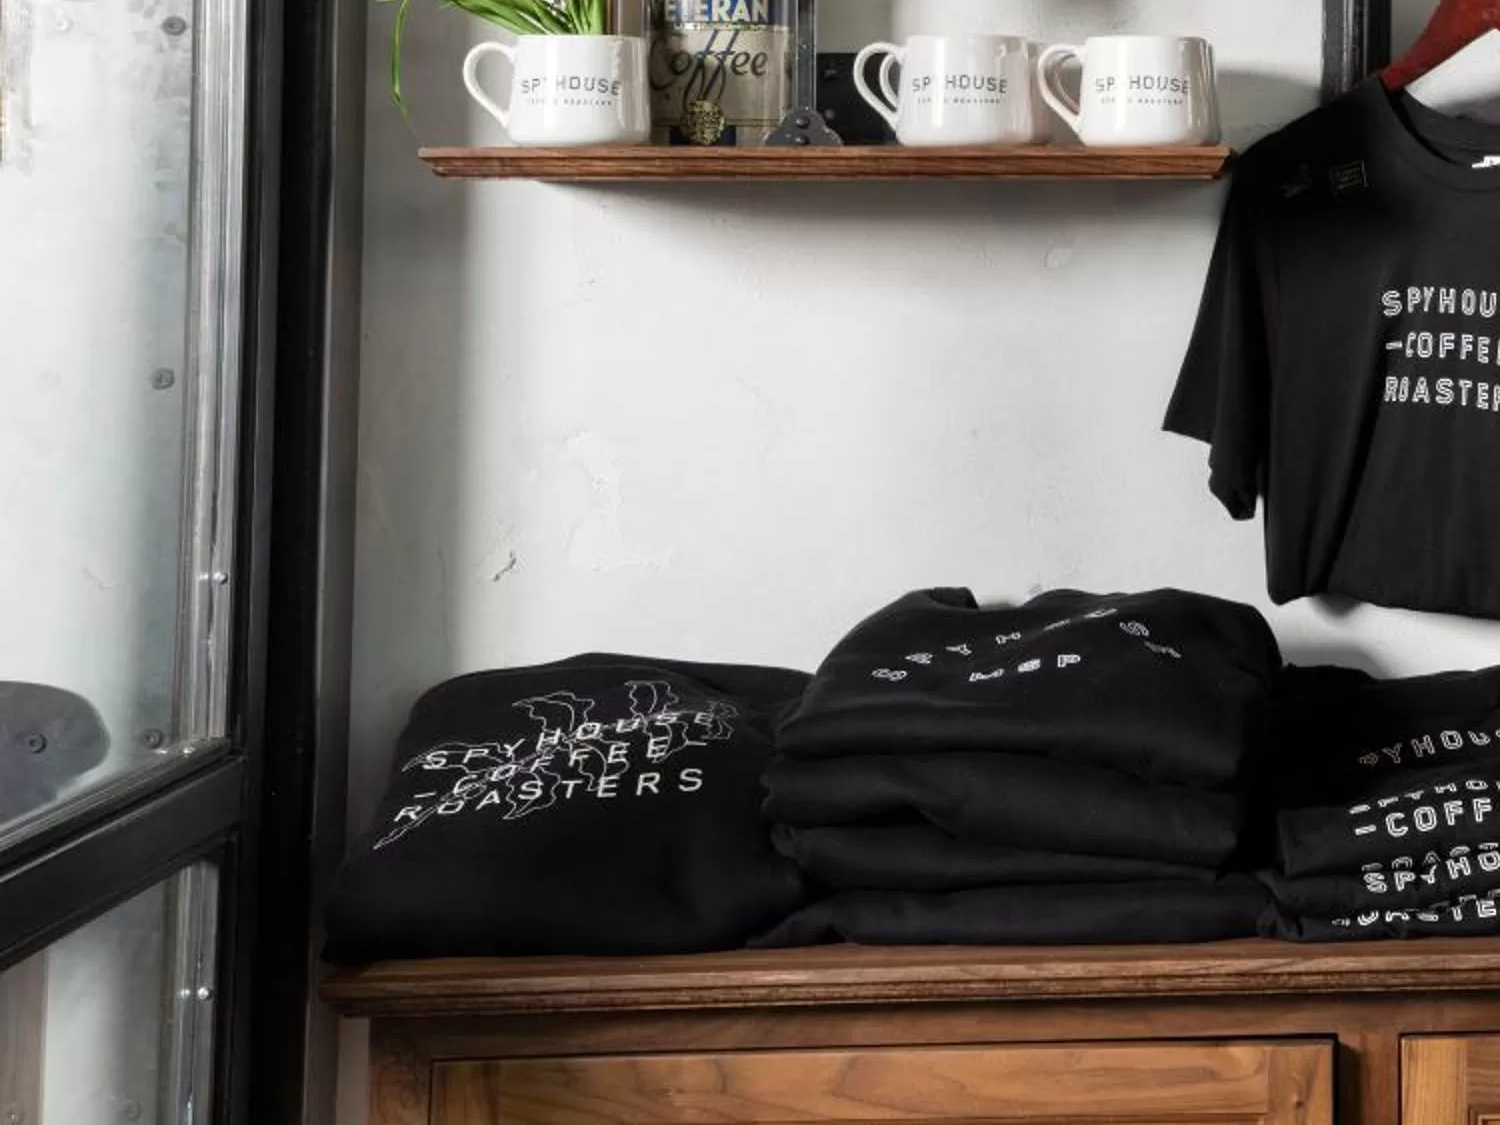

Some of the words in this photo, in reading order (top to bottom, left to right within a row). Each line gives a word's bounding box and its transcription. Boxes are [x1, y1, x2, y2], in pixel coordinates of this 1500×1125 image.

[521, 74, 623, 96] SPHOUSE
[911, 74, 1008, 94] SPHOUSE
[1095, 74, 1189, 95] SPHOUSE
[394, 769, 704, 822] ROASTERS
